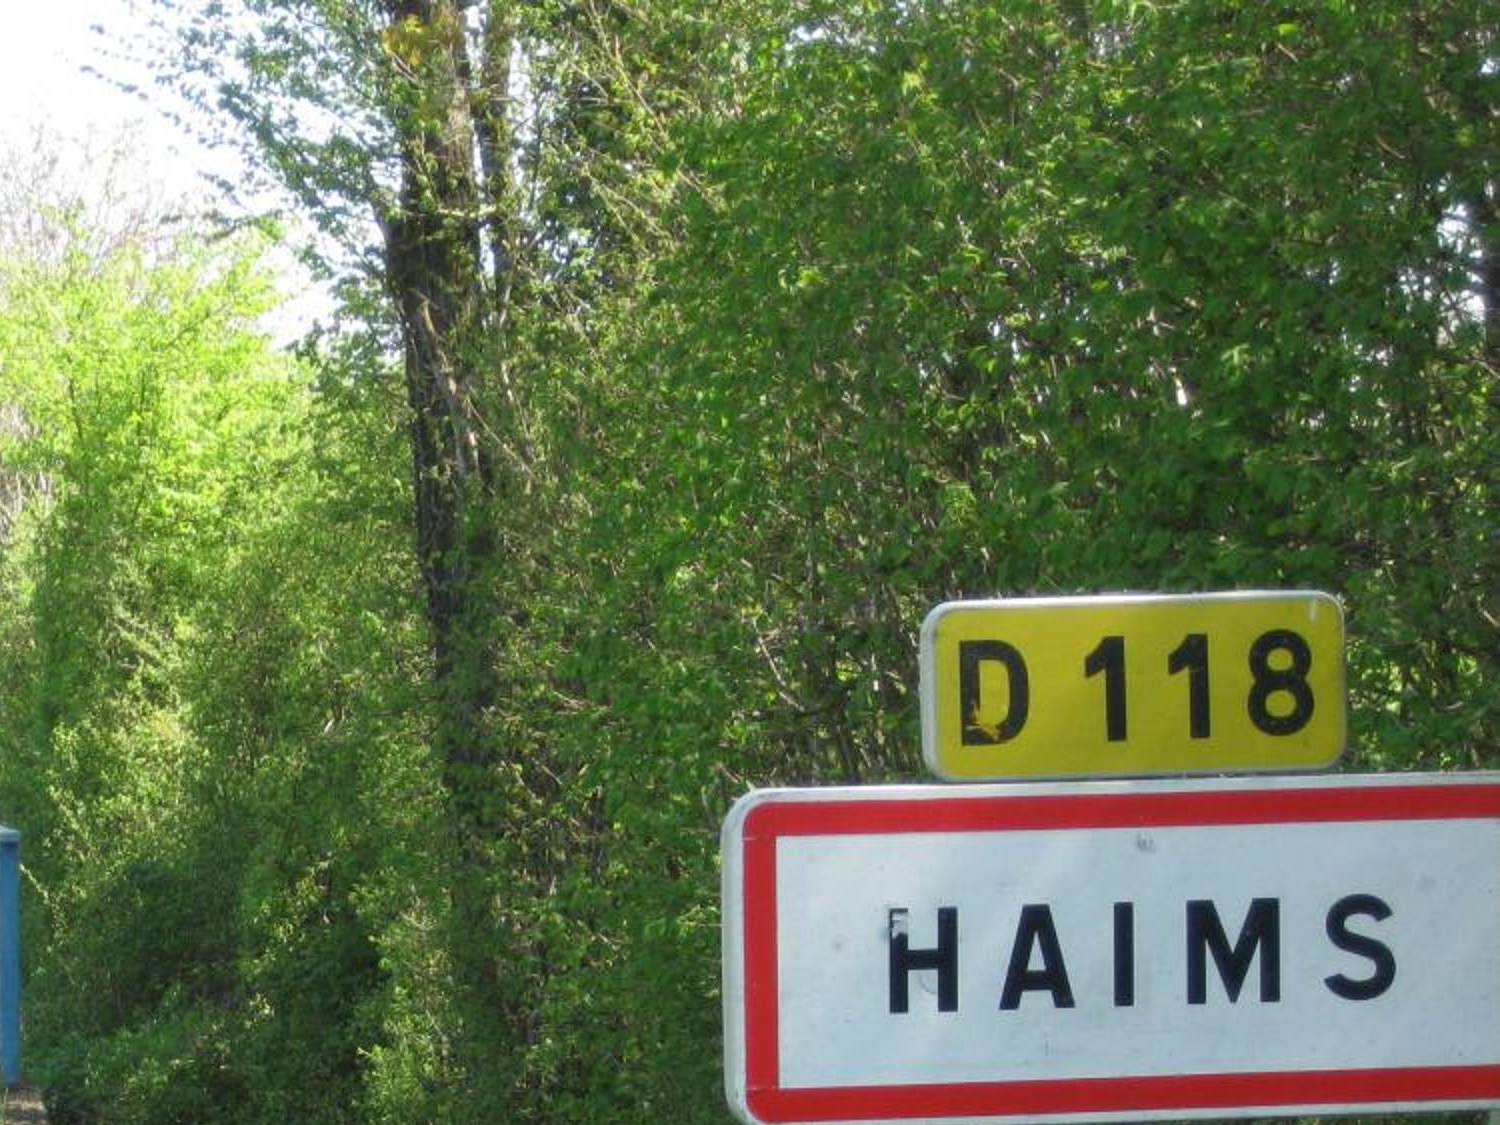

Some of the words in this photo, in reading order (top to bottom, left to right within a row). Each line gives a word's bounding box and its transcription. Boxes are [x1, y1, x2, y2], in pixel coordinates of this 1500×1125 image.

[959, 639, 1029, 746] D
[1084, 628, 1314, 742] 118
[888, 893, 1396, 1014] HAIMS
